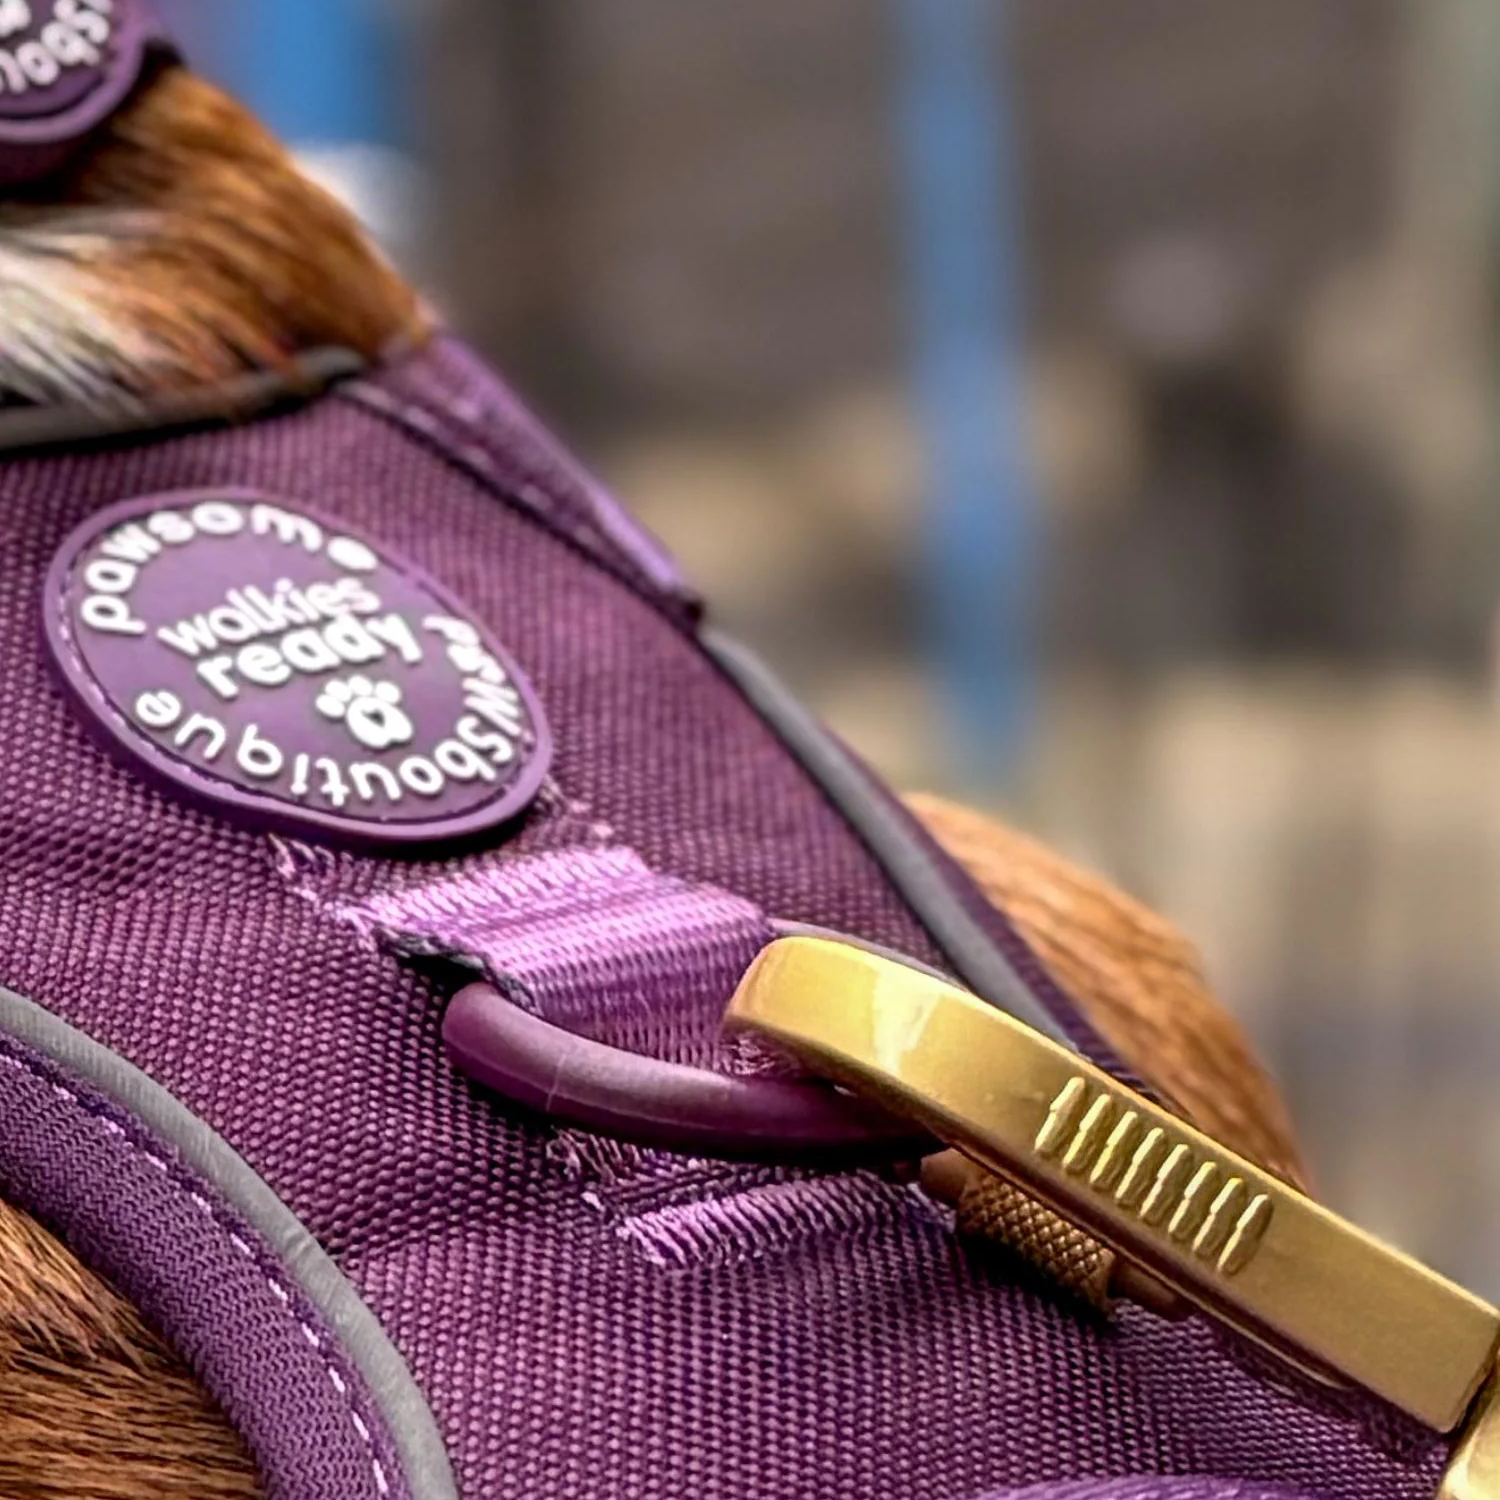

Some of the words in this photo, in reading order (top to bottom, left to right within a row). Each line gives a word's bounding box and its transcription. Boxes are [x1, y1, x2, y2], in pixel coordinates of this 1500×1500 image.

[81, 501, 378, 635] pawsome
[157, 577, 381, 657] walkies
[197, 611, 423, 698] ready
